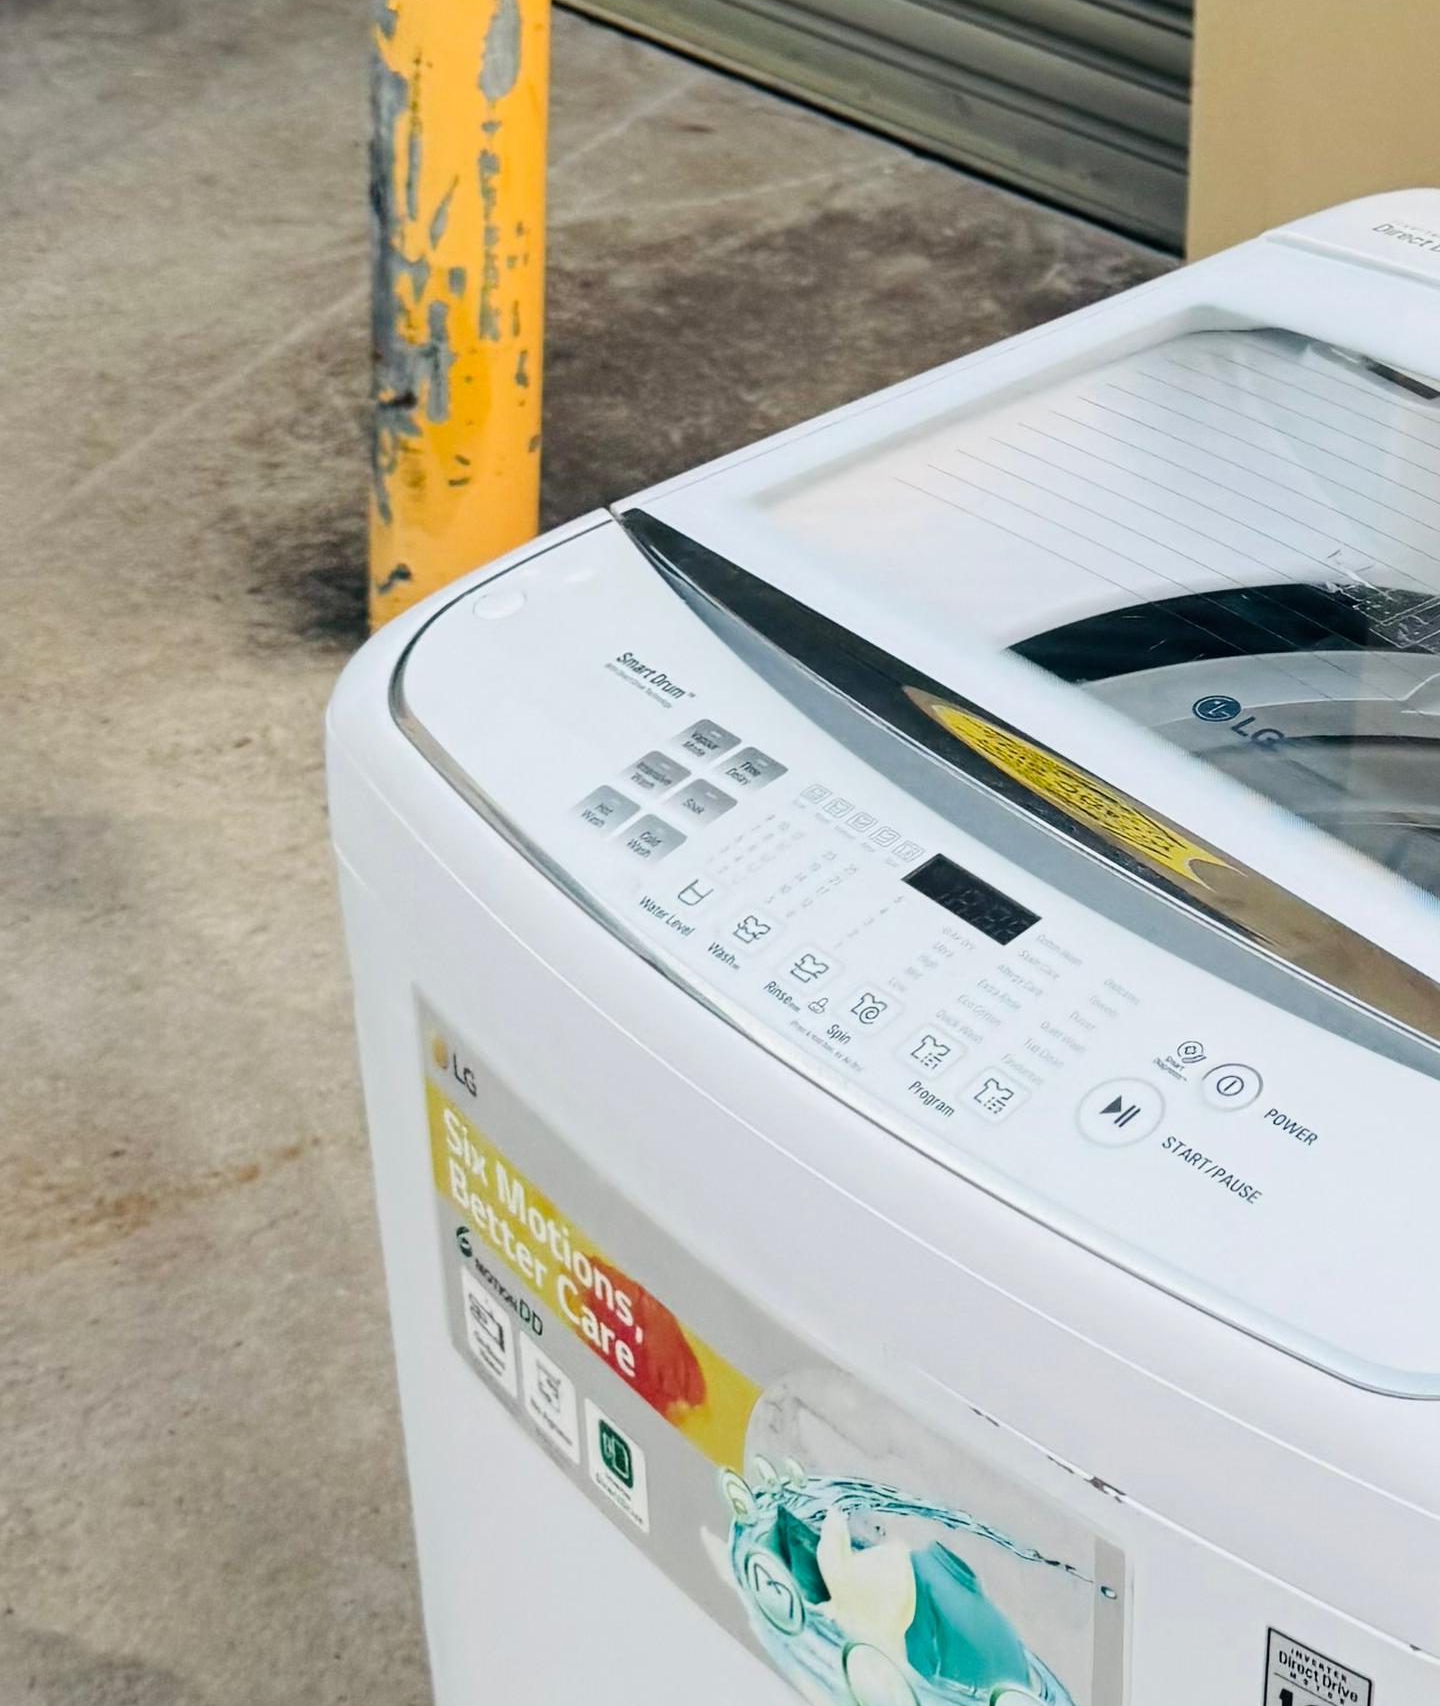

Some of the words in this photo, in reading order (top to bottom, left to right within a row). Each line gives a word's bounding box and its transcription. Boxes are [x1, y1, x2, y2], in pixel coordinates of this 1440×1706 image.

[1372, 223, 1434, 247] Direct
[616, 652, 656, 679] Smart
[639, 895, 669, 920] Water
[665, 913, 696, 937] Level
[707, 941, 736, 967] Wash
[763, 980, 792, 1005] Rinse
[826, 1023, 852, 1045] Spin
[453, 1053, 477, 1097] LG
[908, 1080, 956, 1118] Program
[1263, 1107, 1319, 1146] POWER
[1161, 1135, 1263, 1204] START/PAUSE
[444, 1107, 488, 1187] Six
[496, 1160, 643, 1344] Motions,
[450, 1157, 548, 1289] Better
[556, 1273, 636, 1378] Care
[1278, 1650, 1319, 1683] Direct
[1322, 1674, 1358, 1704] Drive
